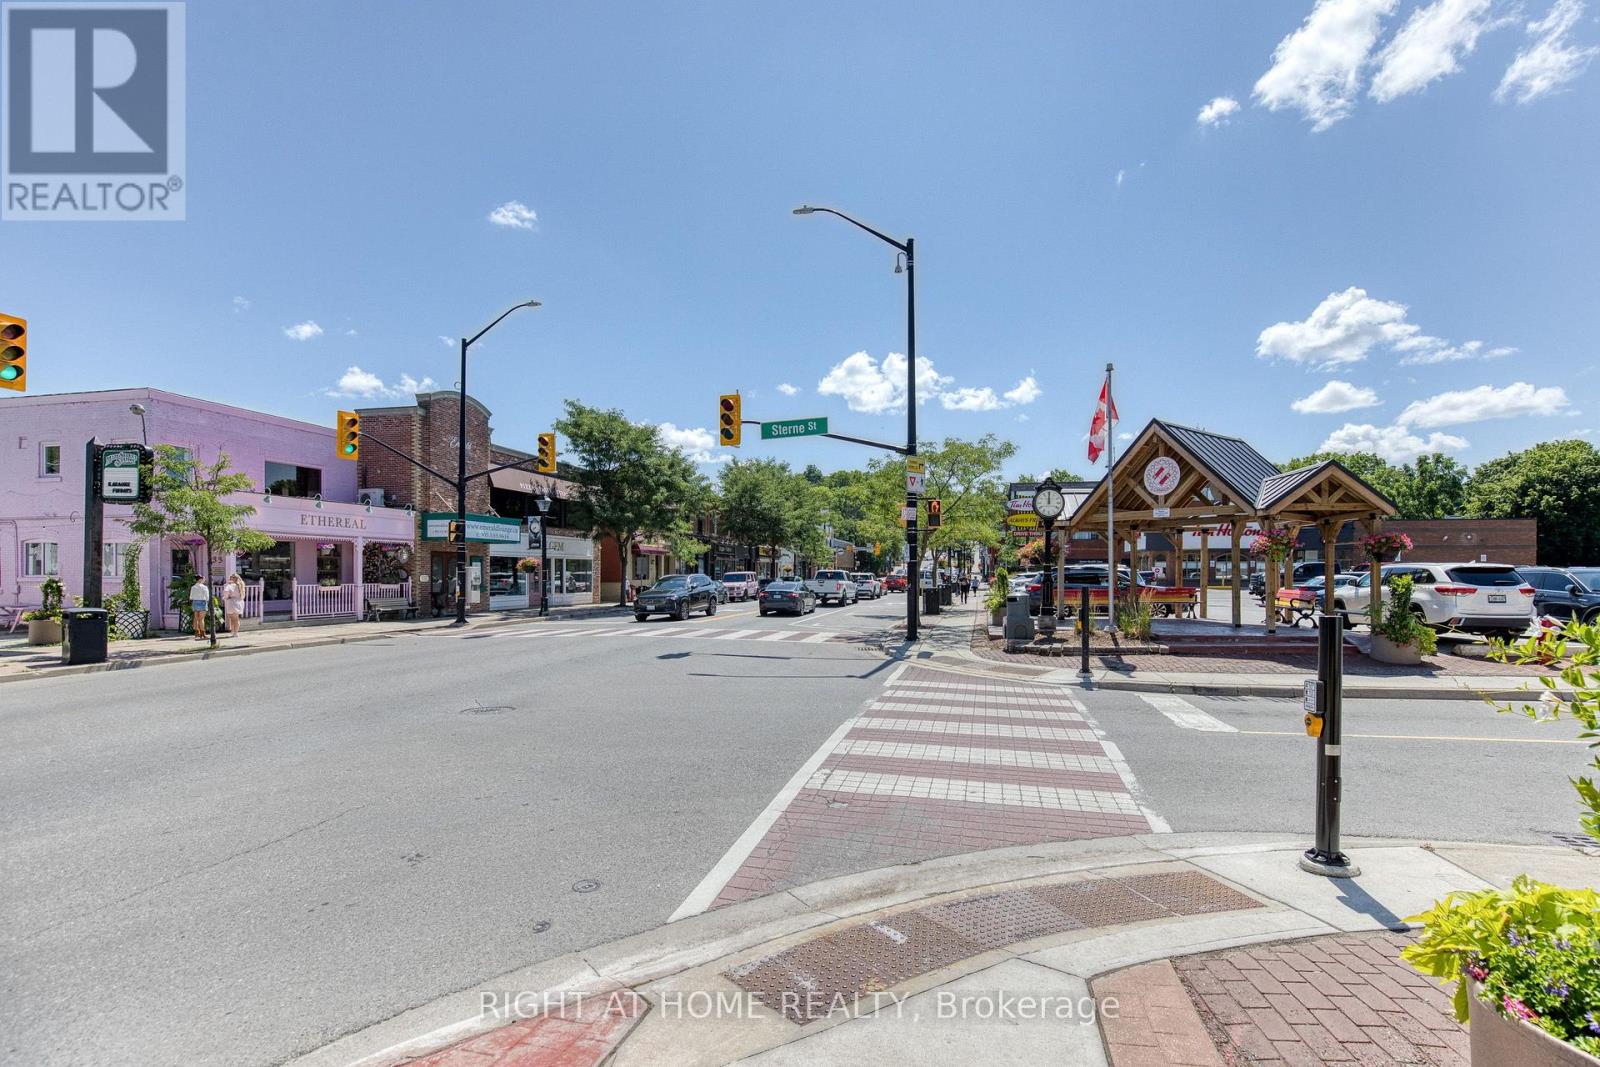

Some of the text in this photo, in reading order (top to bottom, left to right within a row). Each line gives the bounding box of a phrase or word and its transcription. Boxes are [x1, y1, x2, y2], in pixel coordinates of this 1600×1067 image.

[771, 421, 817, 436] Sterne St
[300, 514, 367, 530] ETHEREAL
